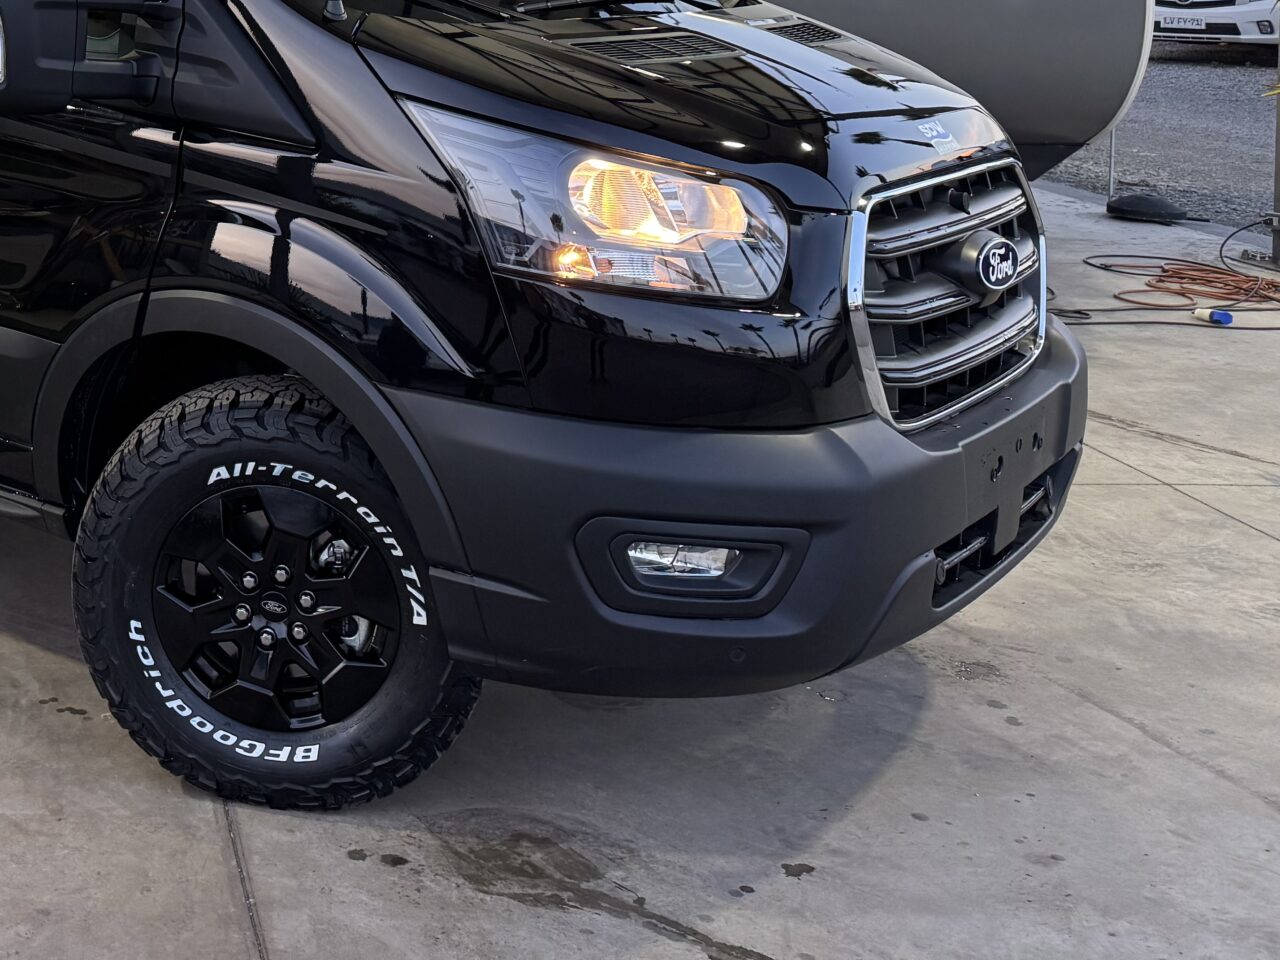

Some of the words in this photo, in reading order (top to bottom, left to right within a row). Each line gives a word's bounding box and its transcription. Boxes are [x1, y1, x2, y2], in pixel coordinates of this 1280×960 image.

[989, 247, 1014, 282] Ford
[207, 461, 404, 557] All-Terrain
[399, 564, 428, 626] T/A
[129, 619, 321, 763] BFGoodrich
